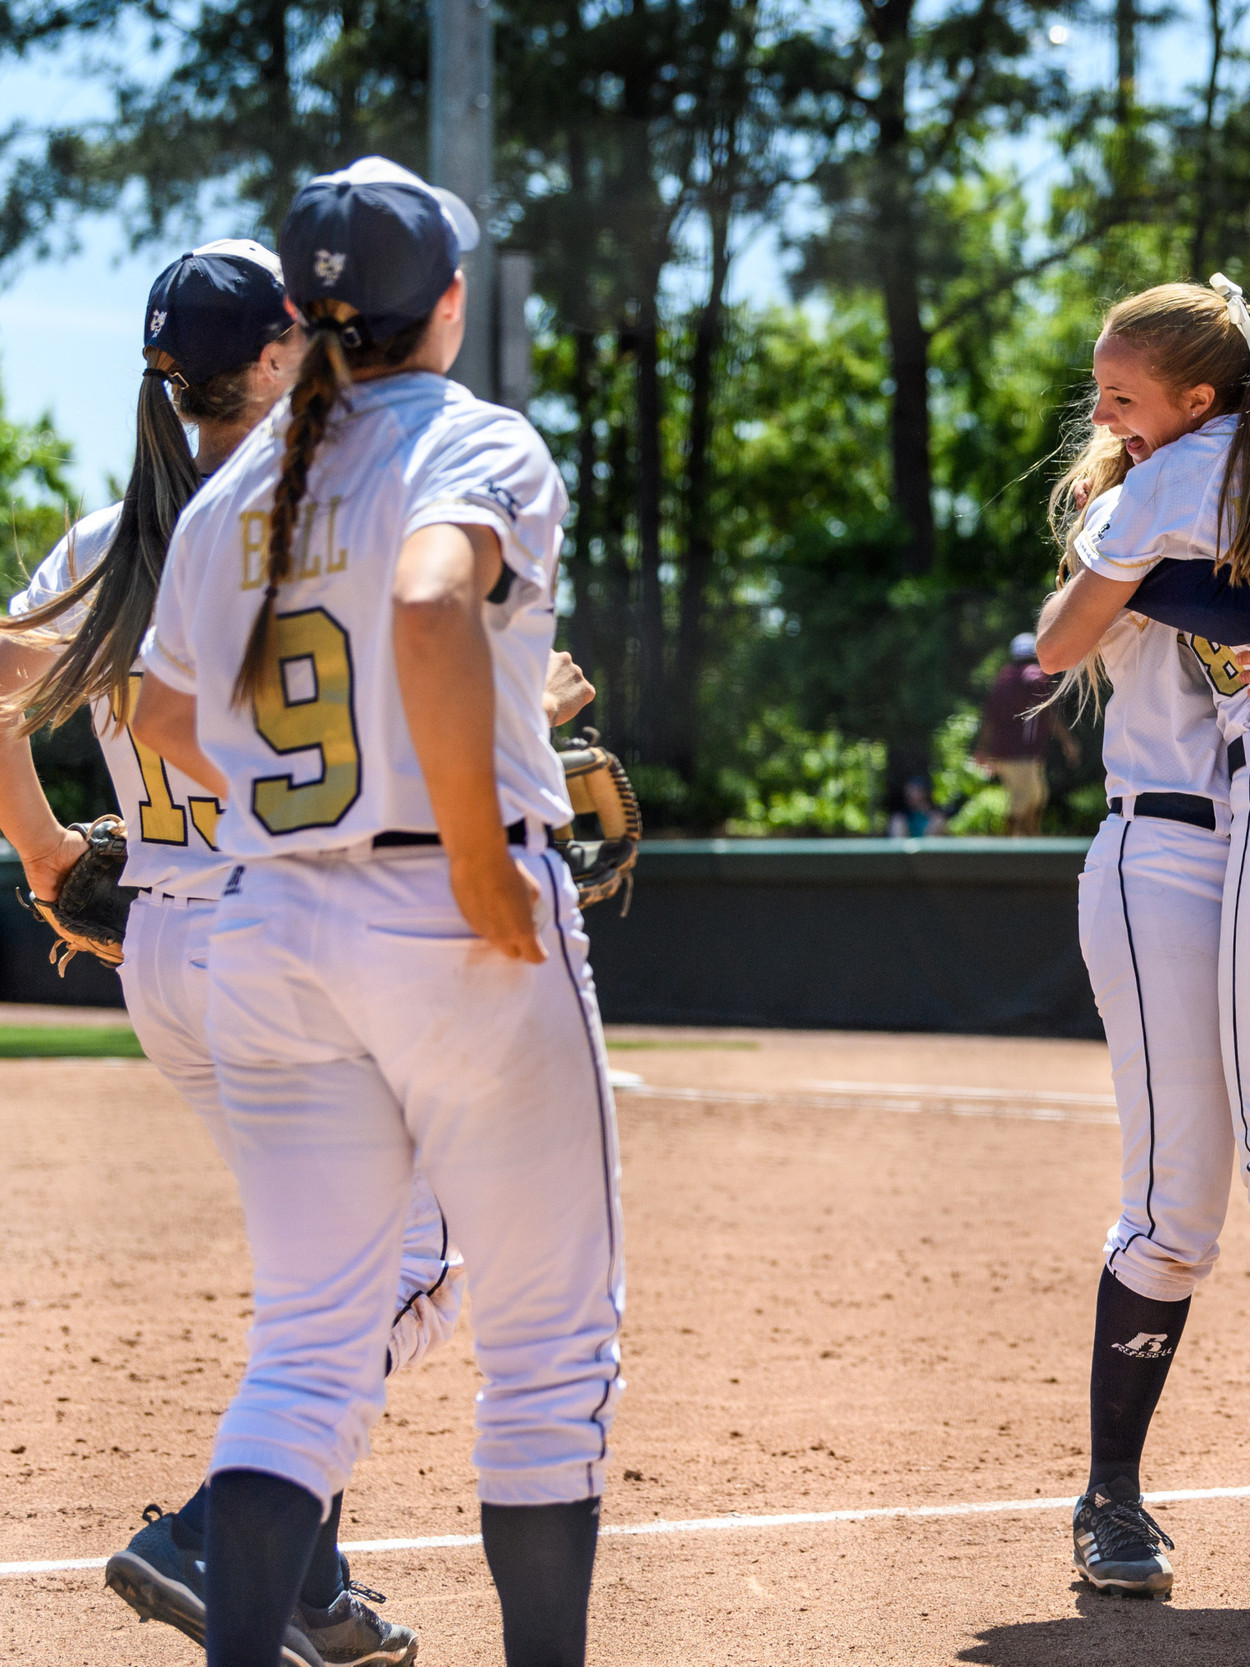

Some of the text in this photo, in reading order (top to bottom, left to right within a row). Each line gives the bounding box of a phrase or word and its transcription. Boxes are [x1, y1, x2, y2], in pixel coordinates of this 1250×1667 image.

[240, 495, 348, 591] BLL
[108, 671, 226, 852] 1
[250, 605, 362, 836] 9
